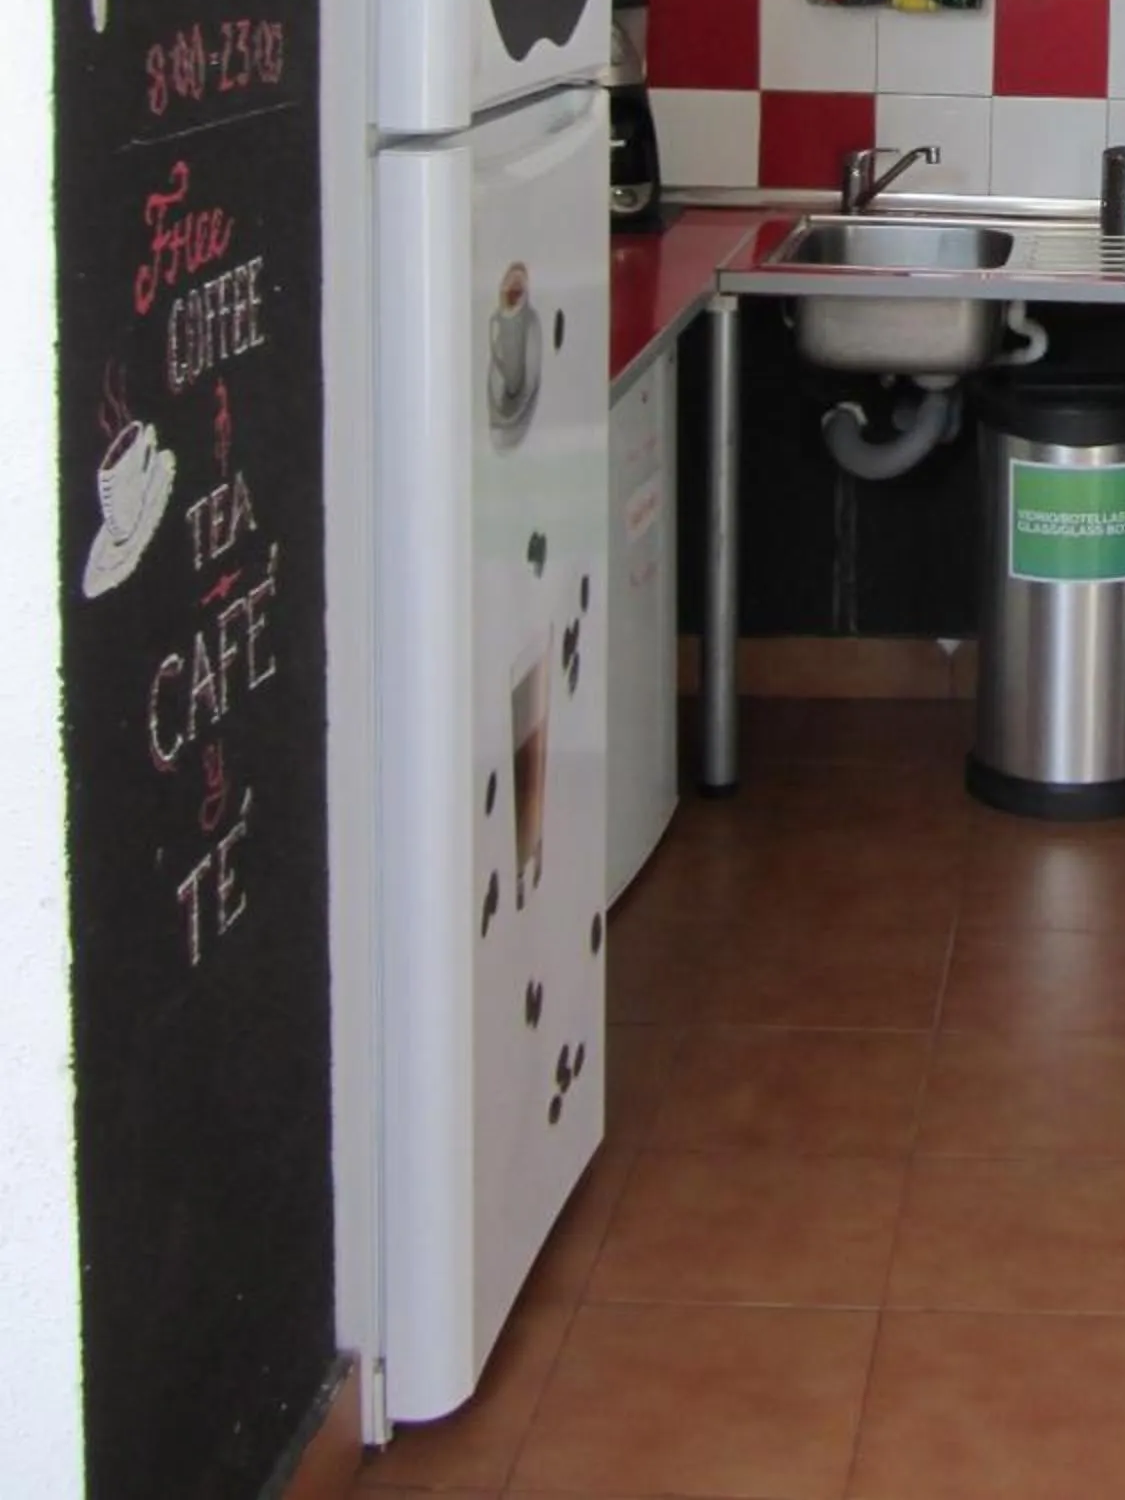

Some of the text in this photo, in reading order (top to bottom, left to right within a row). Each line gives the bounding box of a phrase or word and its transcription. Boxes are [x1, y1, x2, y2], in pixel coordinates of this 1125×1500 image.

[132, 160, 235, 316] Free
[167, 255, 265, 393] COFFEE
[186, 470, 257, 570] TEA
[149, 542, 277, 772] CAFÉ
[177, 786, 253, 967] TÉ
